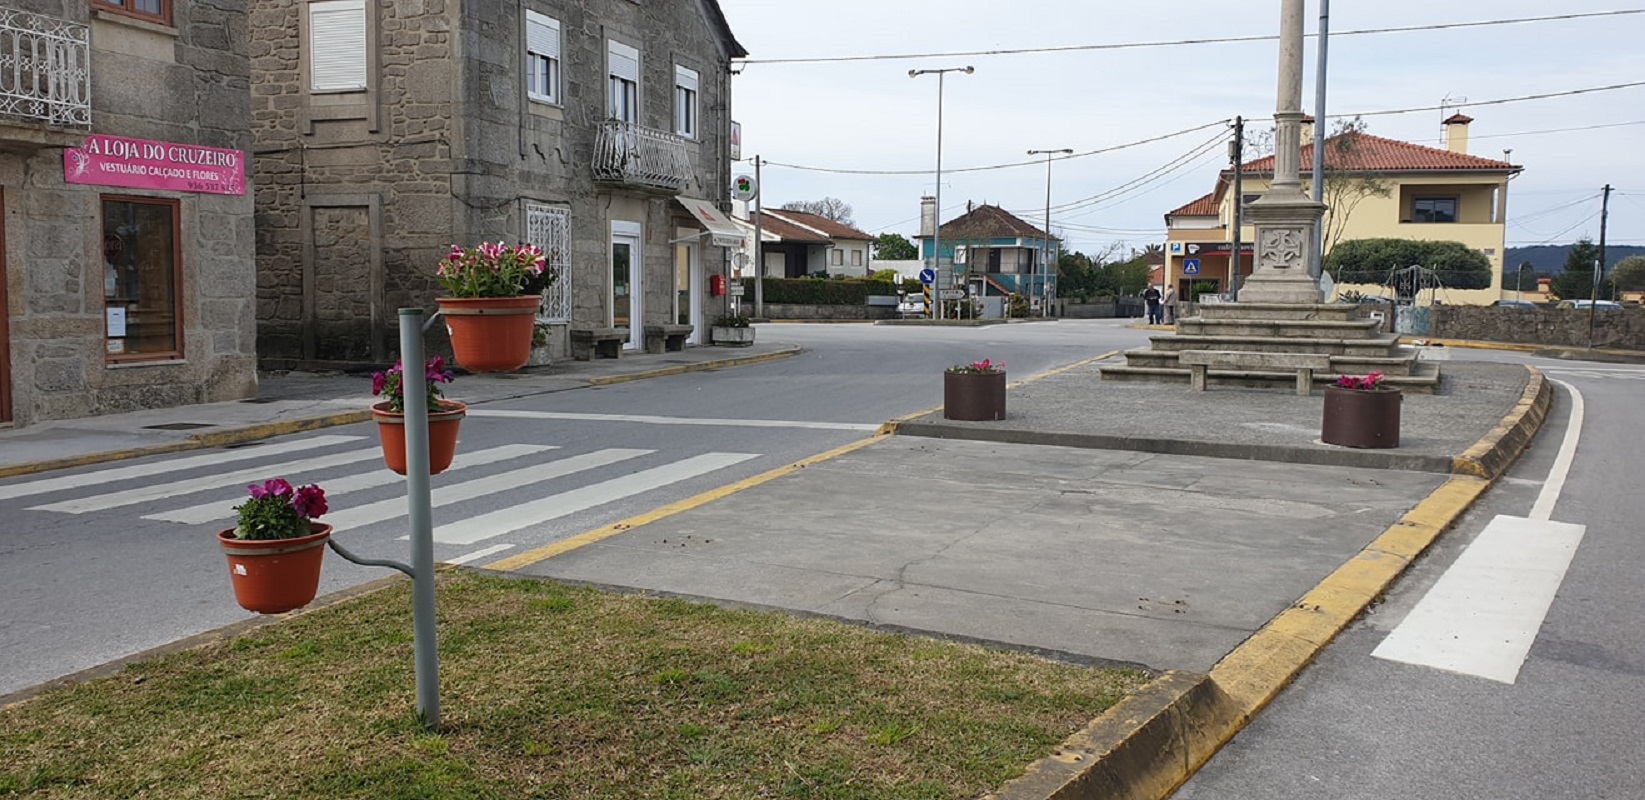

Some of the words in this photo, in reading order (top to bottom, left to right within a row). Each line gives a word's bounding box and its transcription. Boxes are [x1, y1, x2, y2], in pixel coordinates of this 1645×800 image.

[89, 138, 100, 154] A
[104, 139, 140, 160] LOJA
[143, 144, 165, 160] DO
[168, 146, 236, 167] CRUZEIRO
[99, 162, 147, 175] VESTUÁRIO
[148, 166, 185, 179] CALÇADO
[187, 170, 191, 178] E
[193, 170, 219, 180] FLORES
